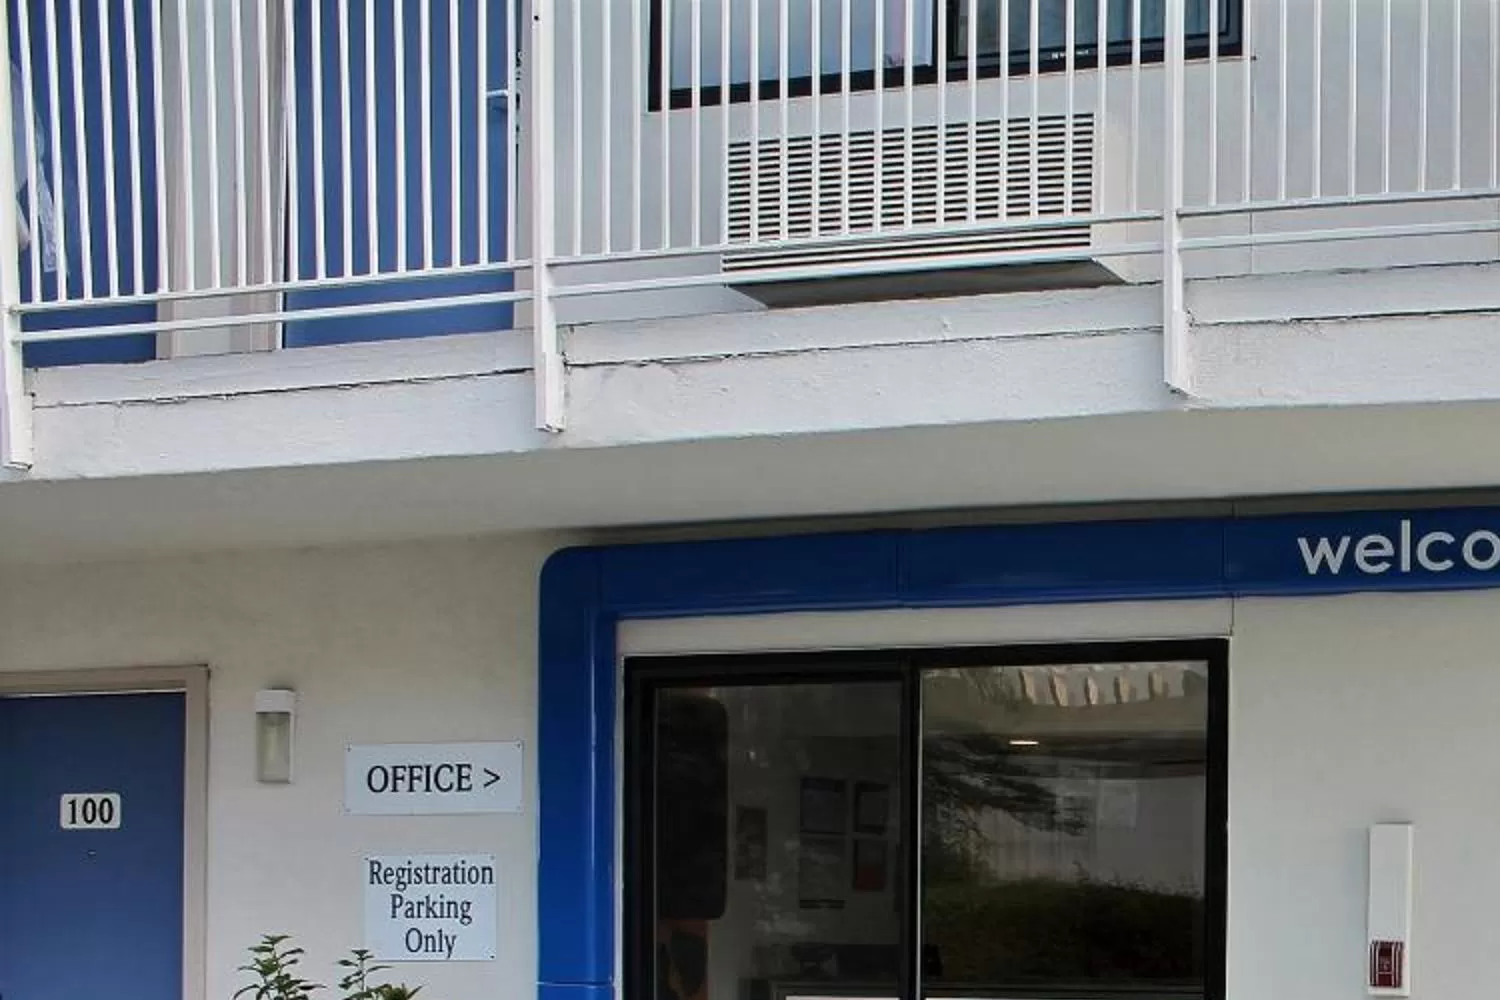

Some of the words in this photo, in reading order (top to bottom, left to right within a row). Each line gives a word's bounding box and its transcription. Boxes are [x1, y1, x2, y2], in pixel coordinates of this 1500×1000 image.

[366, 763, 473, 793] OFFICE
[67, 798, 114, 825] 100
[369, 859, 495, 890] Registration
[390, 893, 473, 925] Parking
[405, 928, 457, 959] Only
